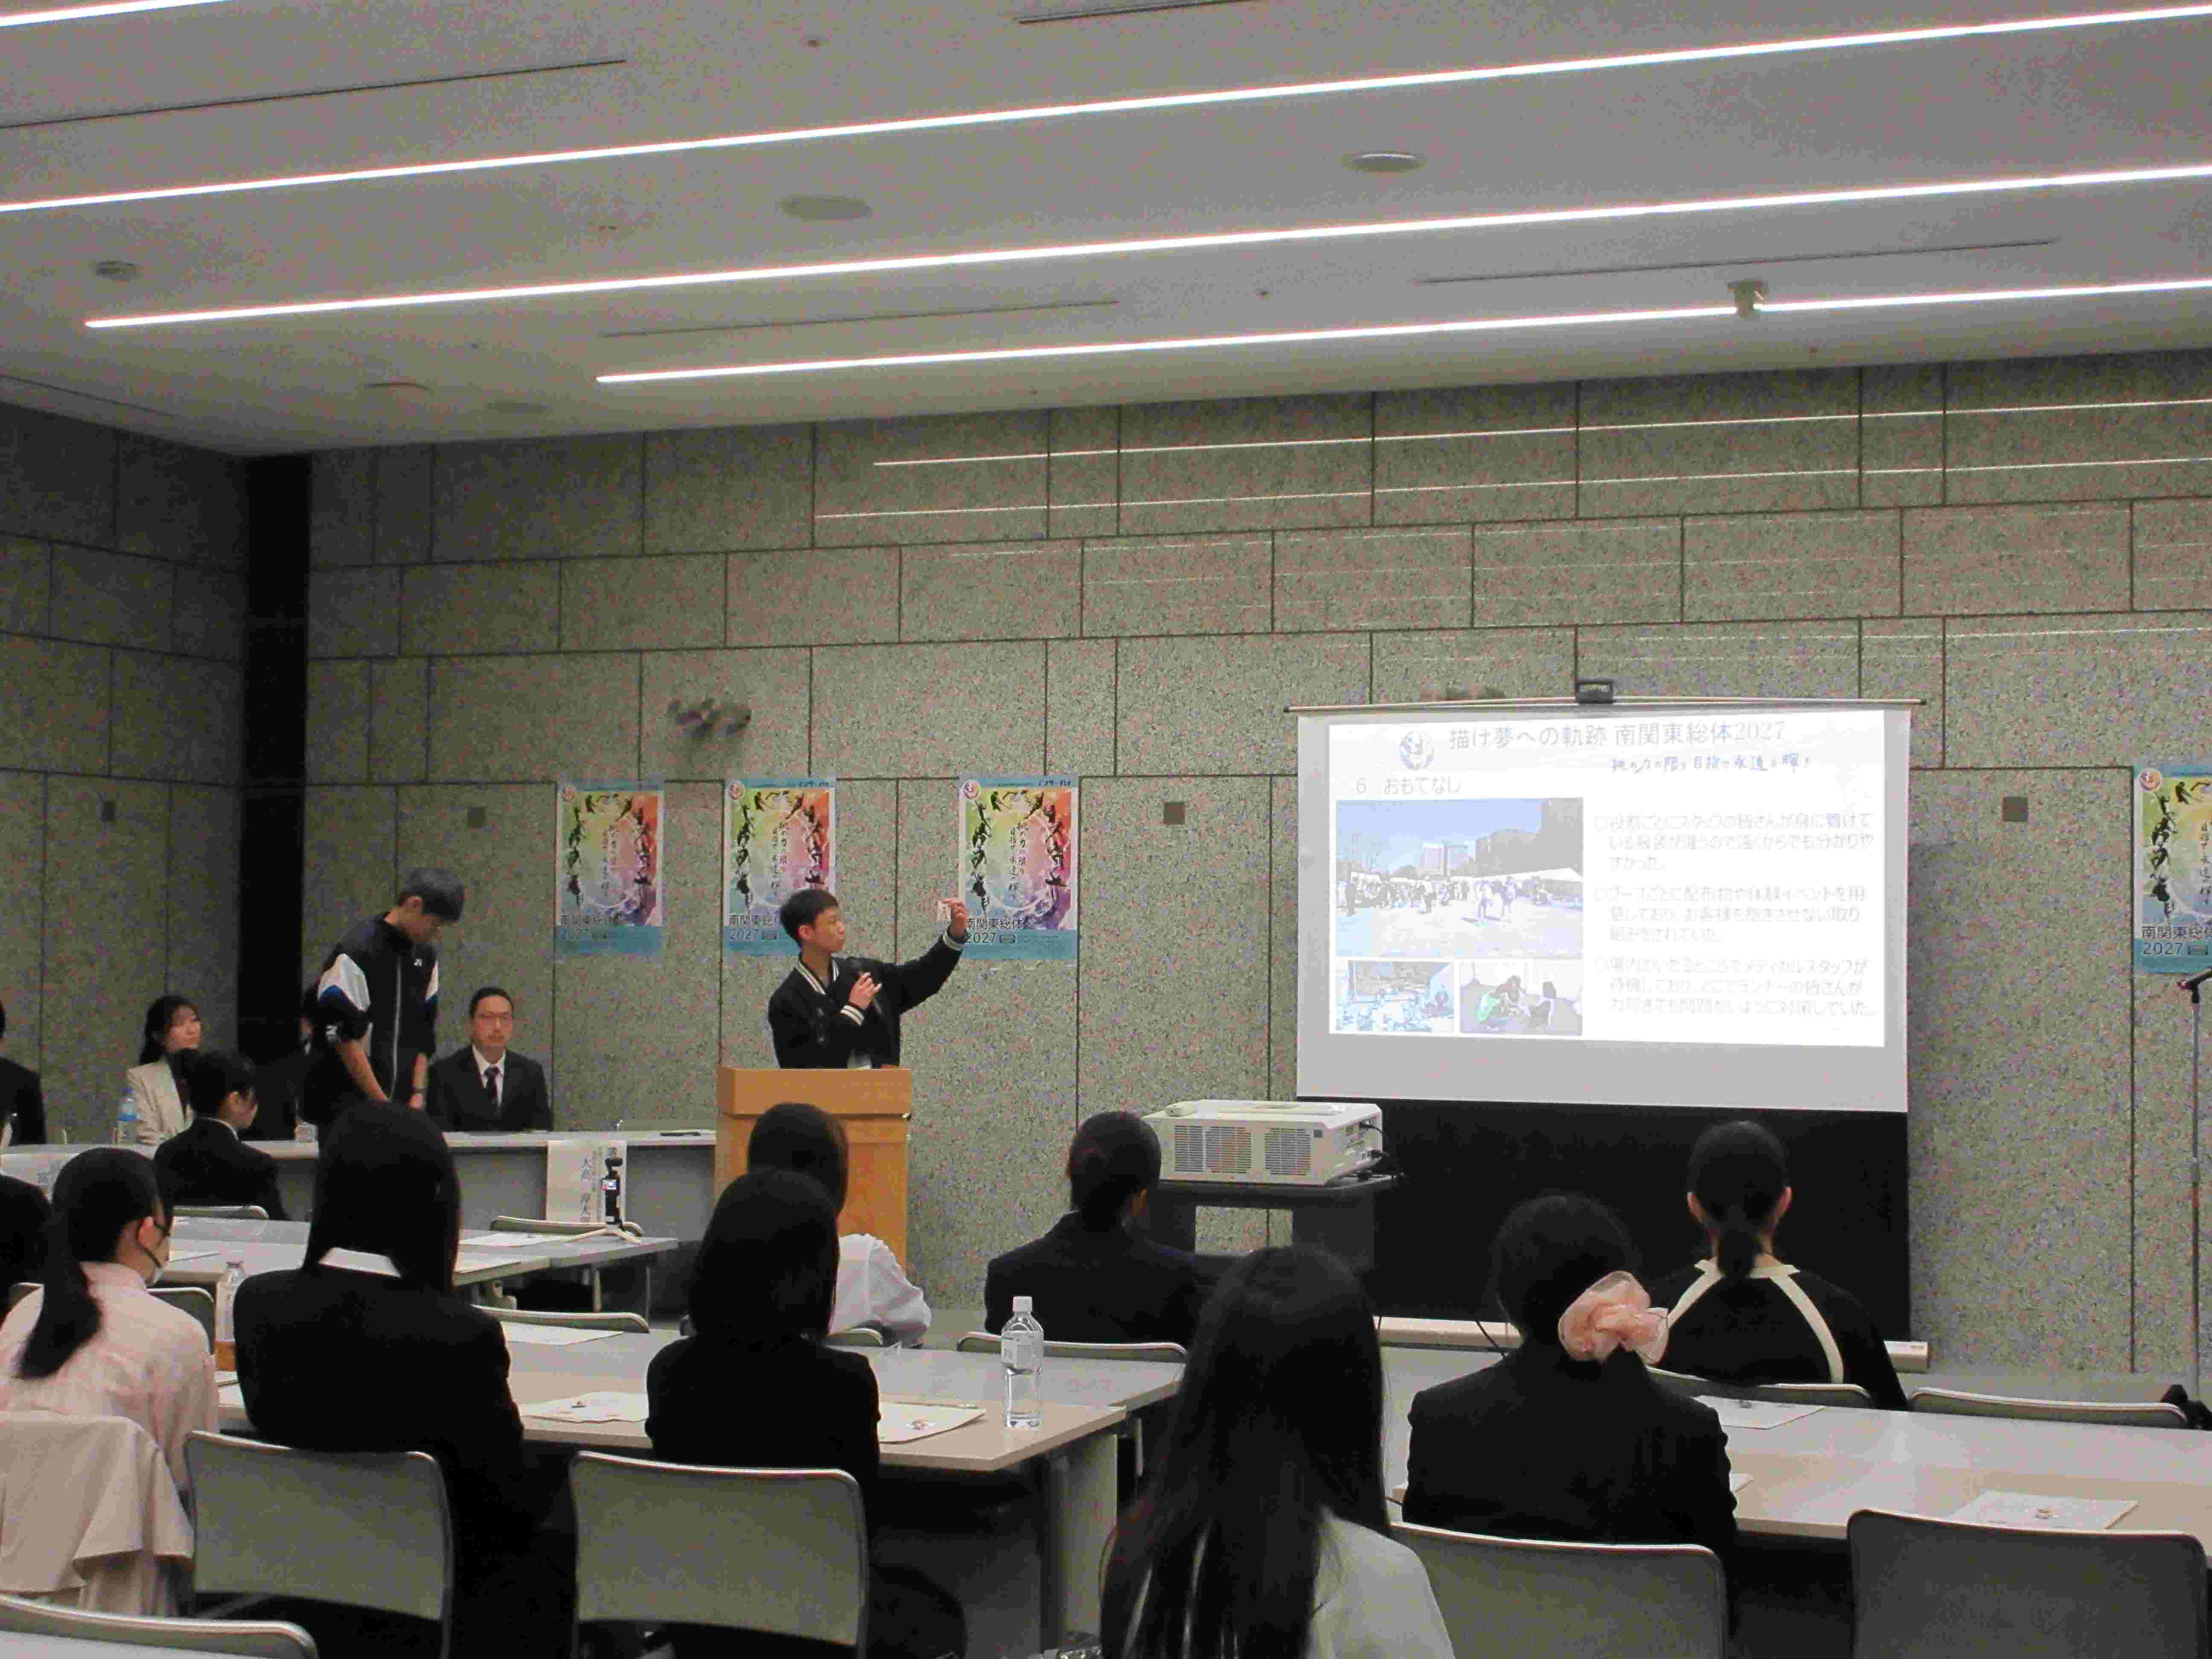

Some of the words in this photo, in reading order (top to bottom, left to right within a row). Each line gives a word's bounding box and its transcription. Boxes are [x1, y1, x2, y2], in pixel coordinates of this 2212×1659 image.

[1449, 725, 1607, 750] 描け夢への軌跡
[1615, 721, 1785, 746] 南関東総体2027
[1356, 777, 1367, 794] 6
[1384, 776, 1461, 795] おもてなし
[966, 918, 1023, 930] 南関東総体
[730, 929, 758, 939] 2027
[966, 932, 996, 943] 2027
[2143, 942, 2183, 955] 2027
